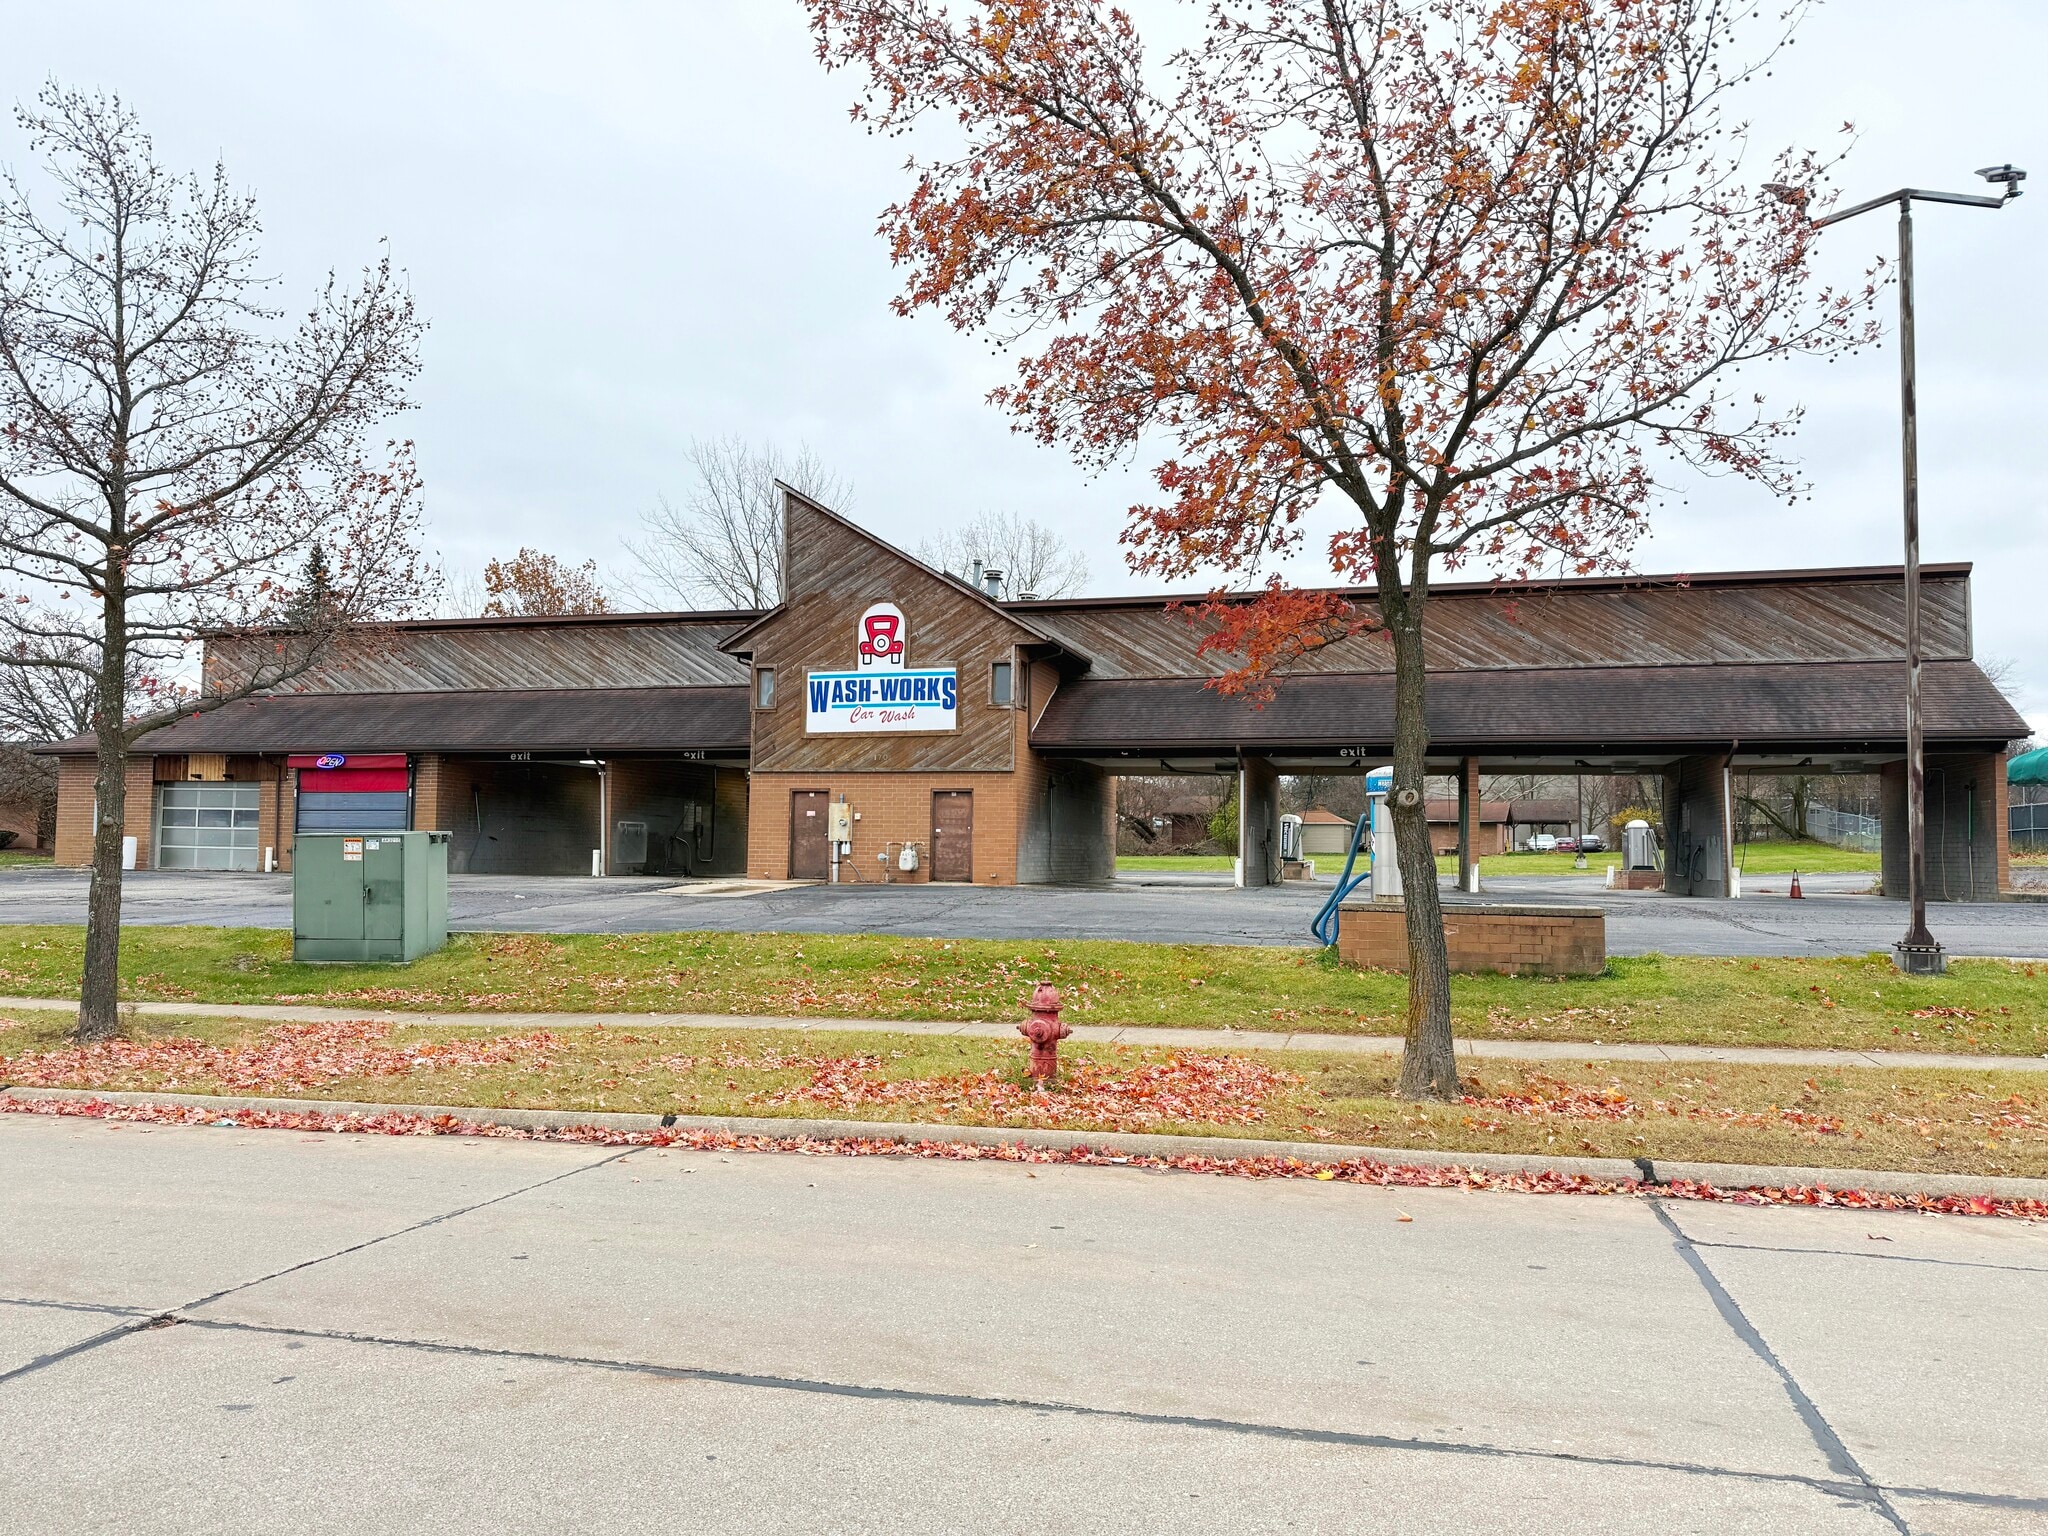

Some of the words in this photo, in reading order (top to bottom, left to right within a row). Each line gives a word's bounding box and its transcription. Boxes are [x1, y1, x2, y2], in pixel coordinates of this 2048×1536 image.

[809, 677, 956, 713] WASH-WORKS
[850, 706, 875, 723] Car
[879, 705, 915, 723] Wash
[510, 751, 531, 761] exit
[684, 750, 705, 759] exit
[1340, 746, 1366, 757] exit
[319, 756, 342, 766] OPEN
